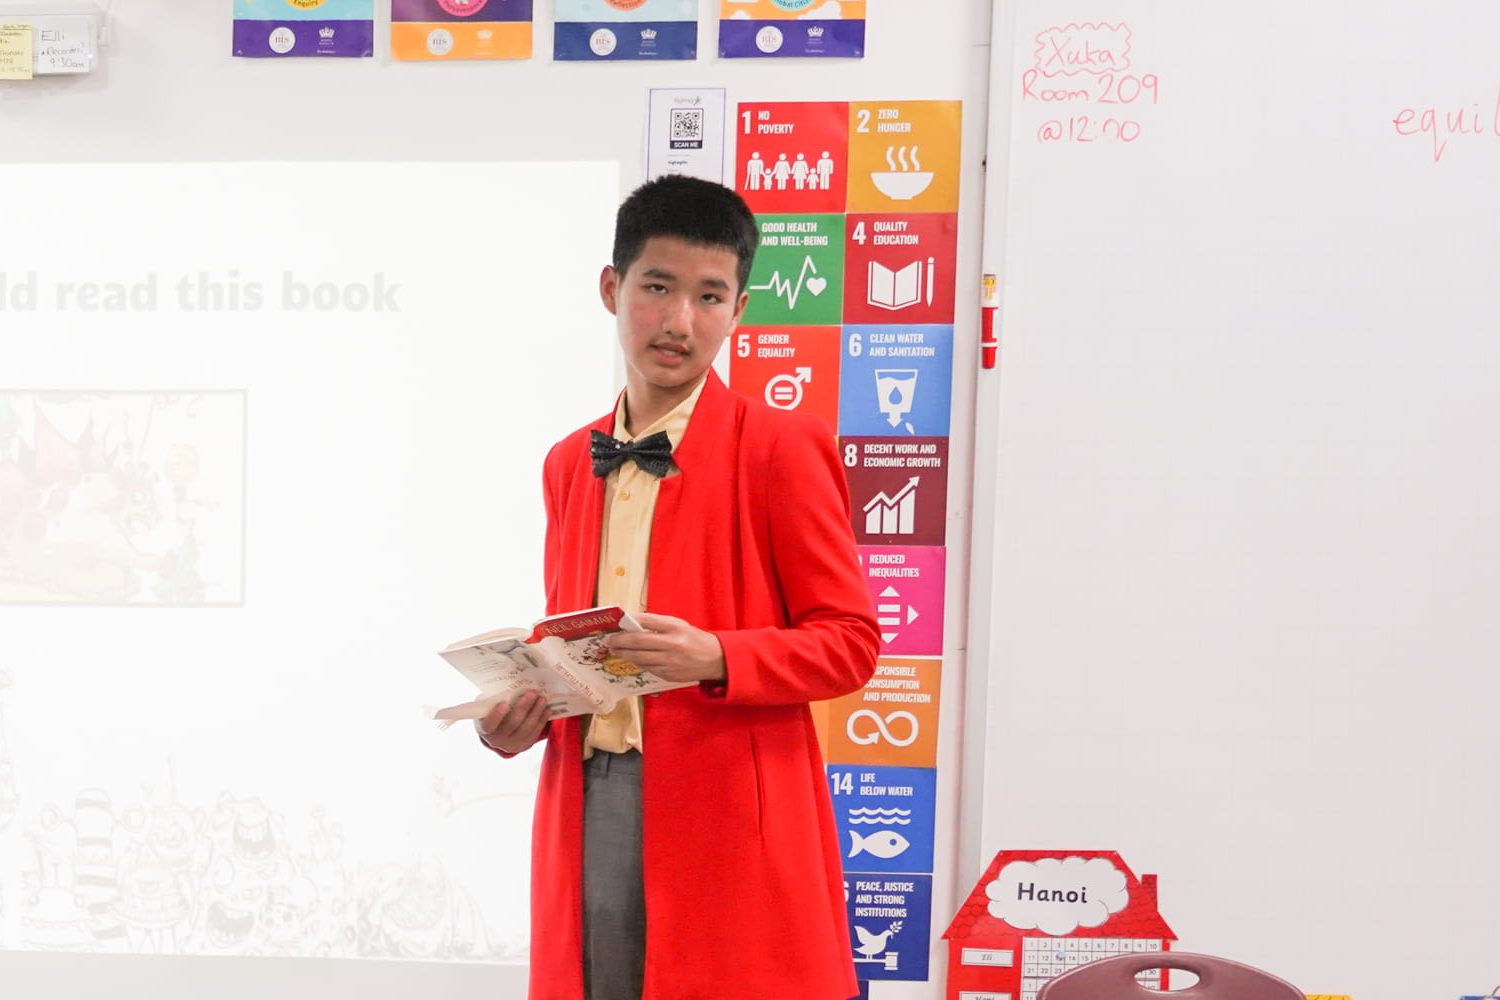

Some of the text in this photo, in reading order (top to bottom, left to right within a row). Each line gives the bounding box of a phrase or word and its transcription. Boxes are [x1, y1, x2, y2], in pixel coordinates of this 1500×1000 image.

[1022, 69, 1159, 104] Room 209
[741, 110, 770, 134] 1 NO
[856, 109, 899, 133] 2 ZERO
[758, 123, 794, 134] POVERTY
[877, 122, 912, 133] HUNGER
[762, 222, 817, 233] GOOD HEALTH
[852, 221, 907, 245] 4 QUALITY
[761, 236, 828, 246] AND WELL-BEING
[873, 234, 919, 245] EDUCATION
[55, 271, 158, 312] read
[175, 268, 264, 312] this
[282, 270, 402, 312] book
[737, 334, 789, 358] 5 GENDER
[848, 333, 924, 357] 6 CLEAN WATER
[757, 347, 795, 358] EQUALITY
[869, 347, 935, 357] AND SANITATION
[844, 444, 937, 467] 8 DECENT WORK AND
[864, 457, 941, 467] ECONOMIC GROWTH
[869, 554, 905, 564] REDUCED
[869, 567, 920, 577] INEQUALITIES
[545, 613, 616, 635] NEIL GAIMAN
[863, 691, 931, 703] AND PRODUCTION
[831, 773, 876, 795] 14 LIFE
[860, 786, 913, 796] BELOW WATER
[856, 881, 914, 893] PEACE, JUSTICE
[1017, 882, 1088, 904] Hanoi
[856, 894, 904, 905] AND STRONG
[855, 907, 907, 918] INSTITUTIONS
